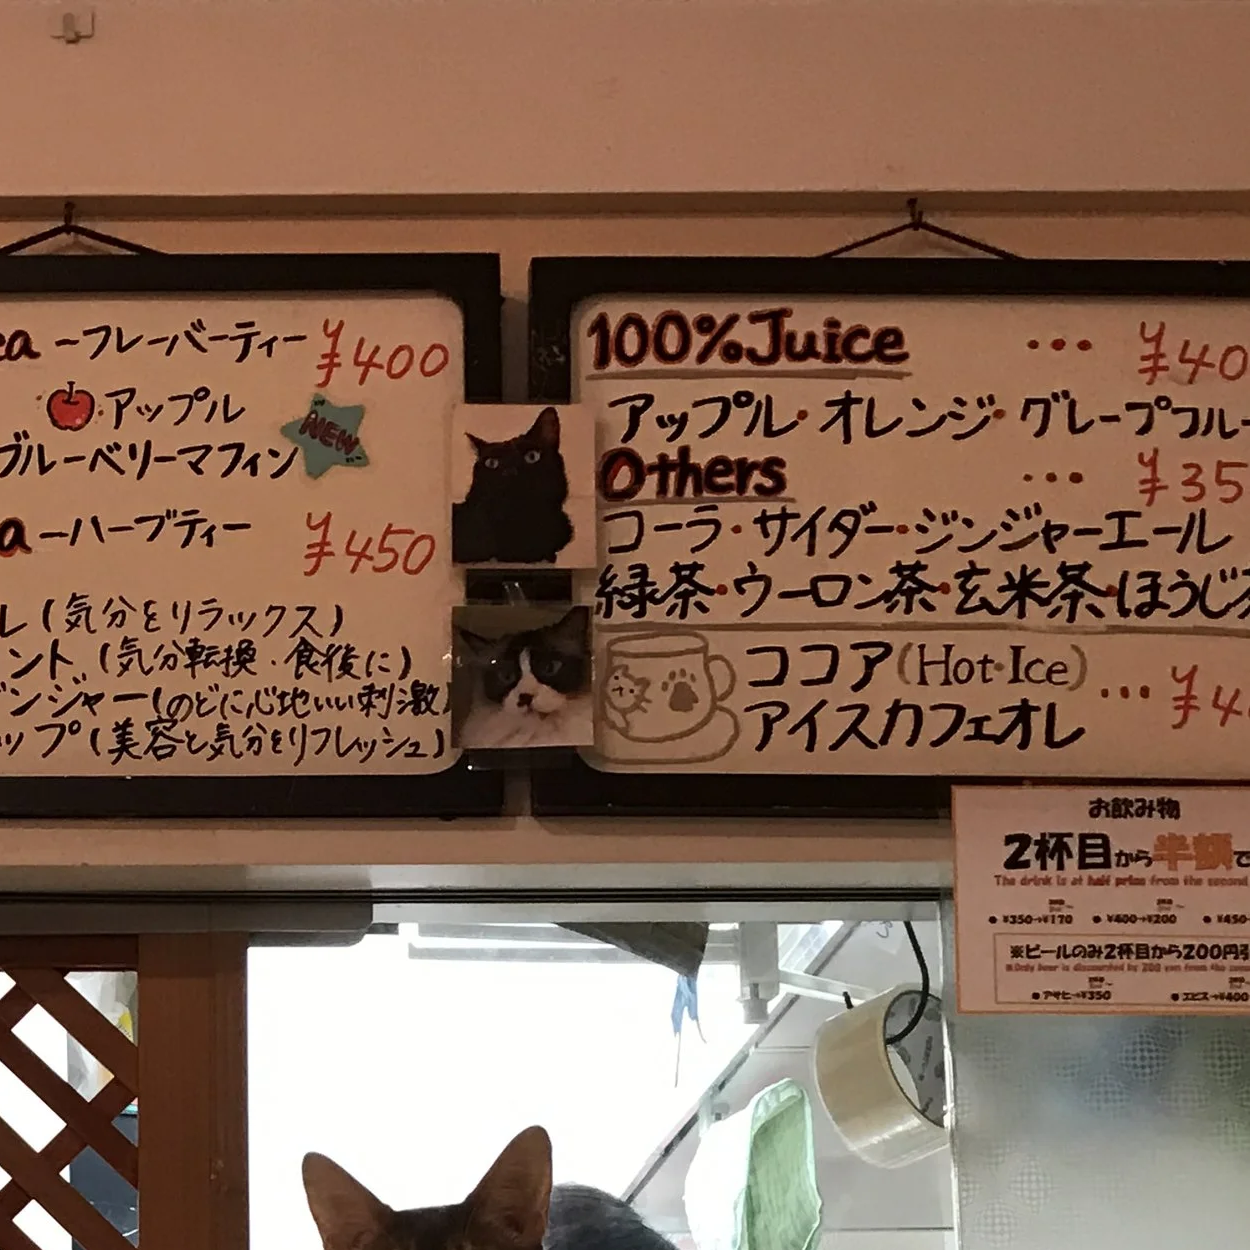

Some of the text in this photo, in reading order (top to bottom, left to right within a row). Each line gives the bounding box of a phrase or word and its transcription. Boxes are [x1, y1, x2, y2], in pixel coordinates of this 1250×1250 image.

[315, 318, 450, 387] ¥400
[104, 385, 246, 430] アップル
[298, 407, 362, 457] NEW
[600, 446, 1245, 506] Others ¥35
[303, 511, 437, 577] ¥450
[1169, 664, 1250, 729] ¥4
[744, 699, 1086, 753] アイスカフェオレ
[1088, 796, 1181, 820] お飲み物
[994, 874, 1018, 887] The
[1020, 874, 1052, 887] drink
